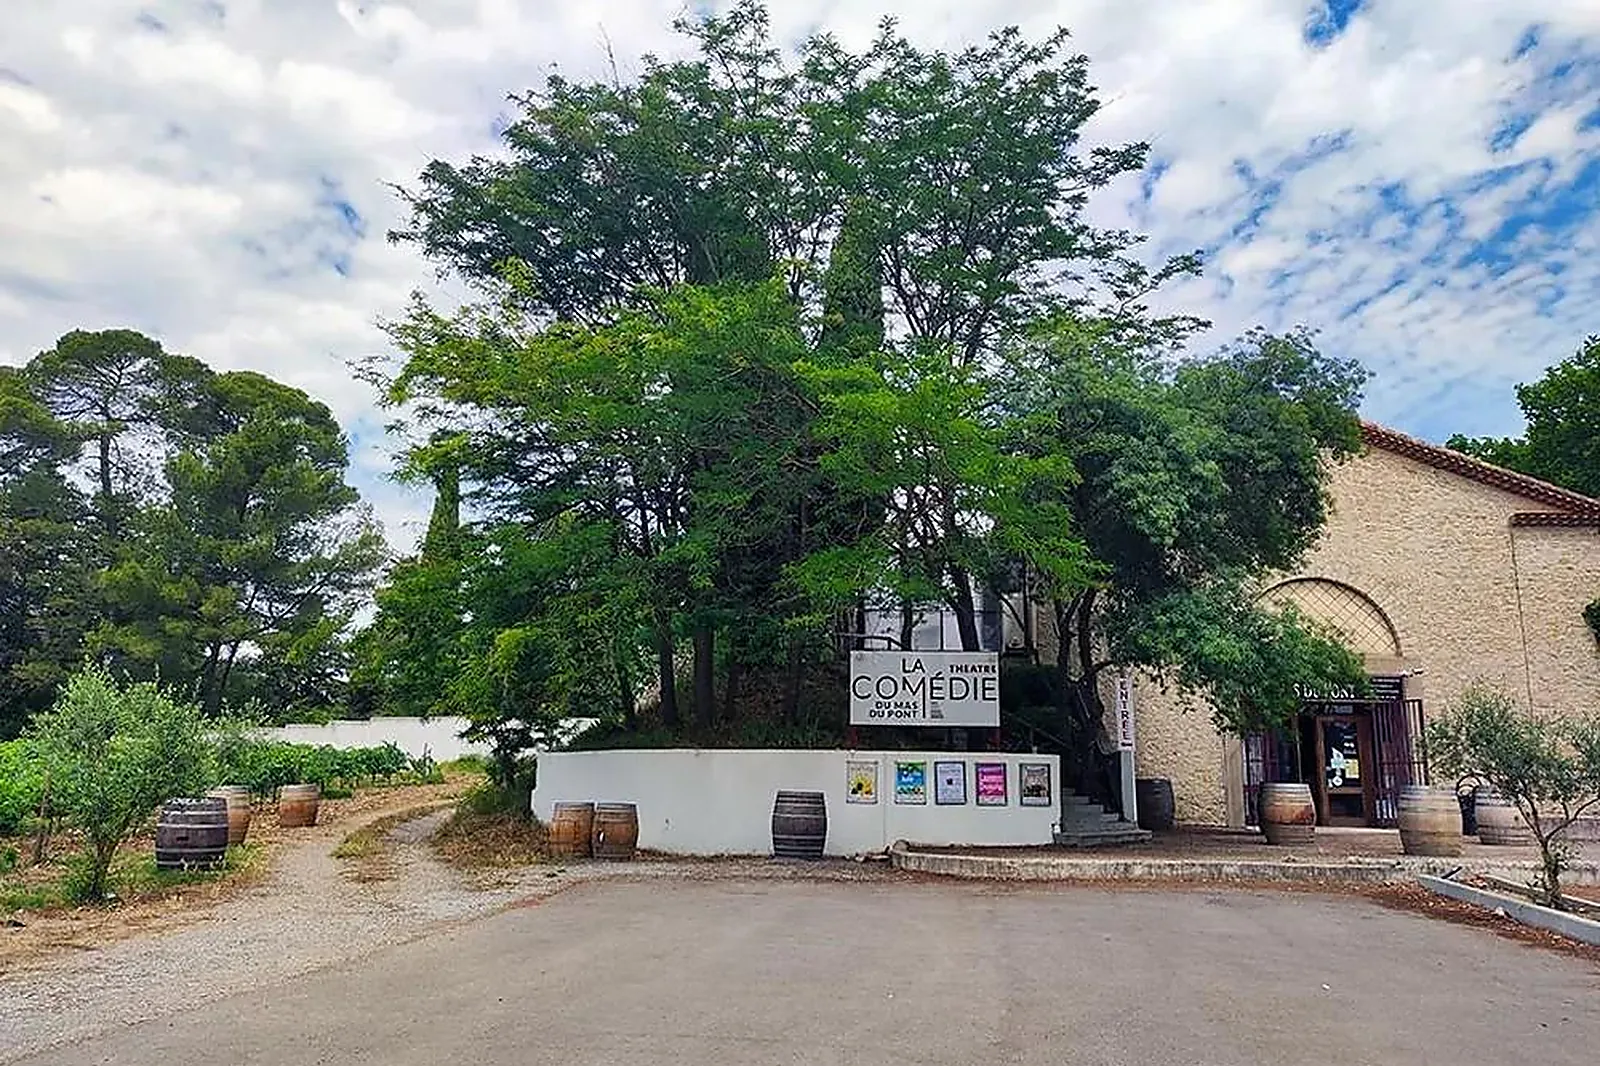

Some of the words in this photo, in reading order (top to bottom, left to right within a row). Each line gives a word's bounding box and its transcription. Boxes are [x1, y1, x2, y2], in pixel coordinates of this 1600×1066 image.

[902, 658, 926, 674] LA
[949, 664, 997, 674] THEATRE
[852, 671, 997, 718] COMÉDIE
[875, 701, 891, 710] DU
[894, 701, 918, 710] MAS
[869, 710, 884, 718] DU
[887, 710, 919, 718] PONT
